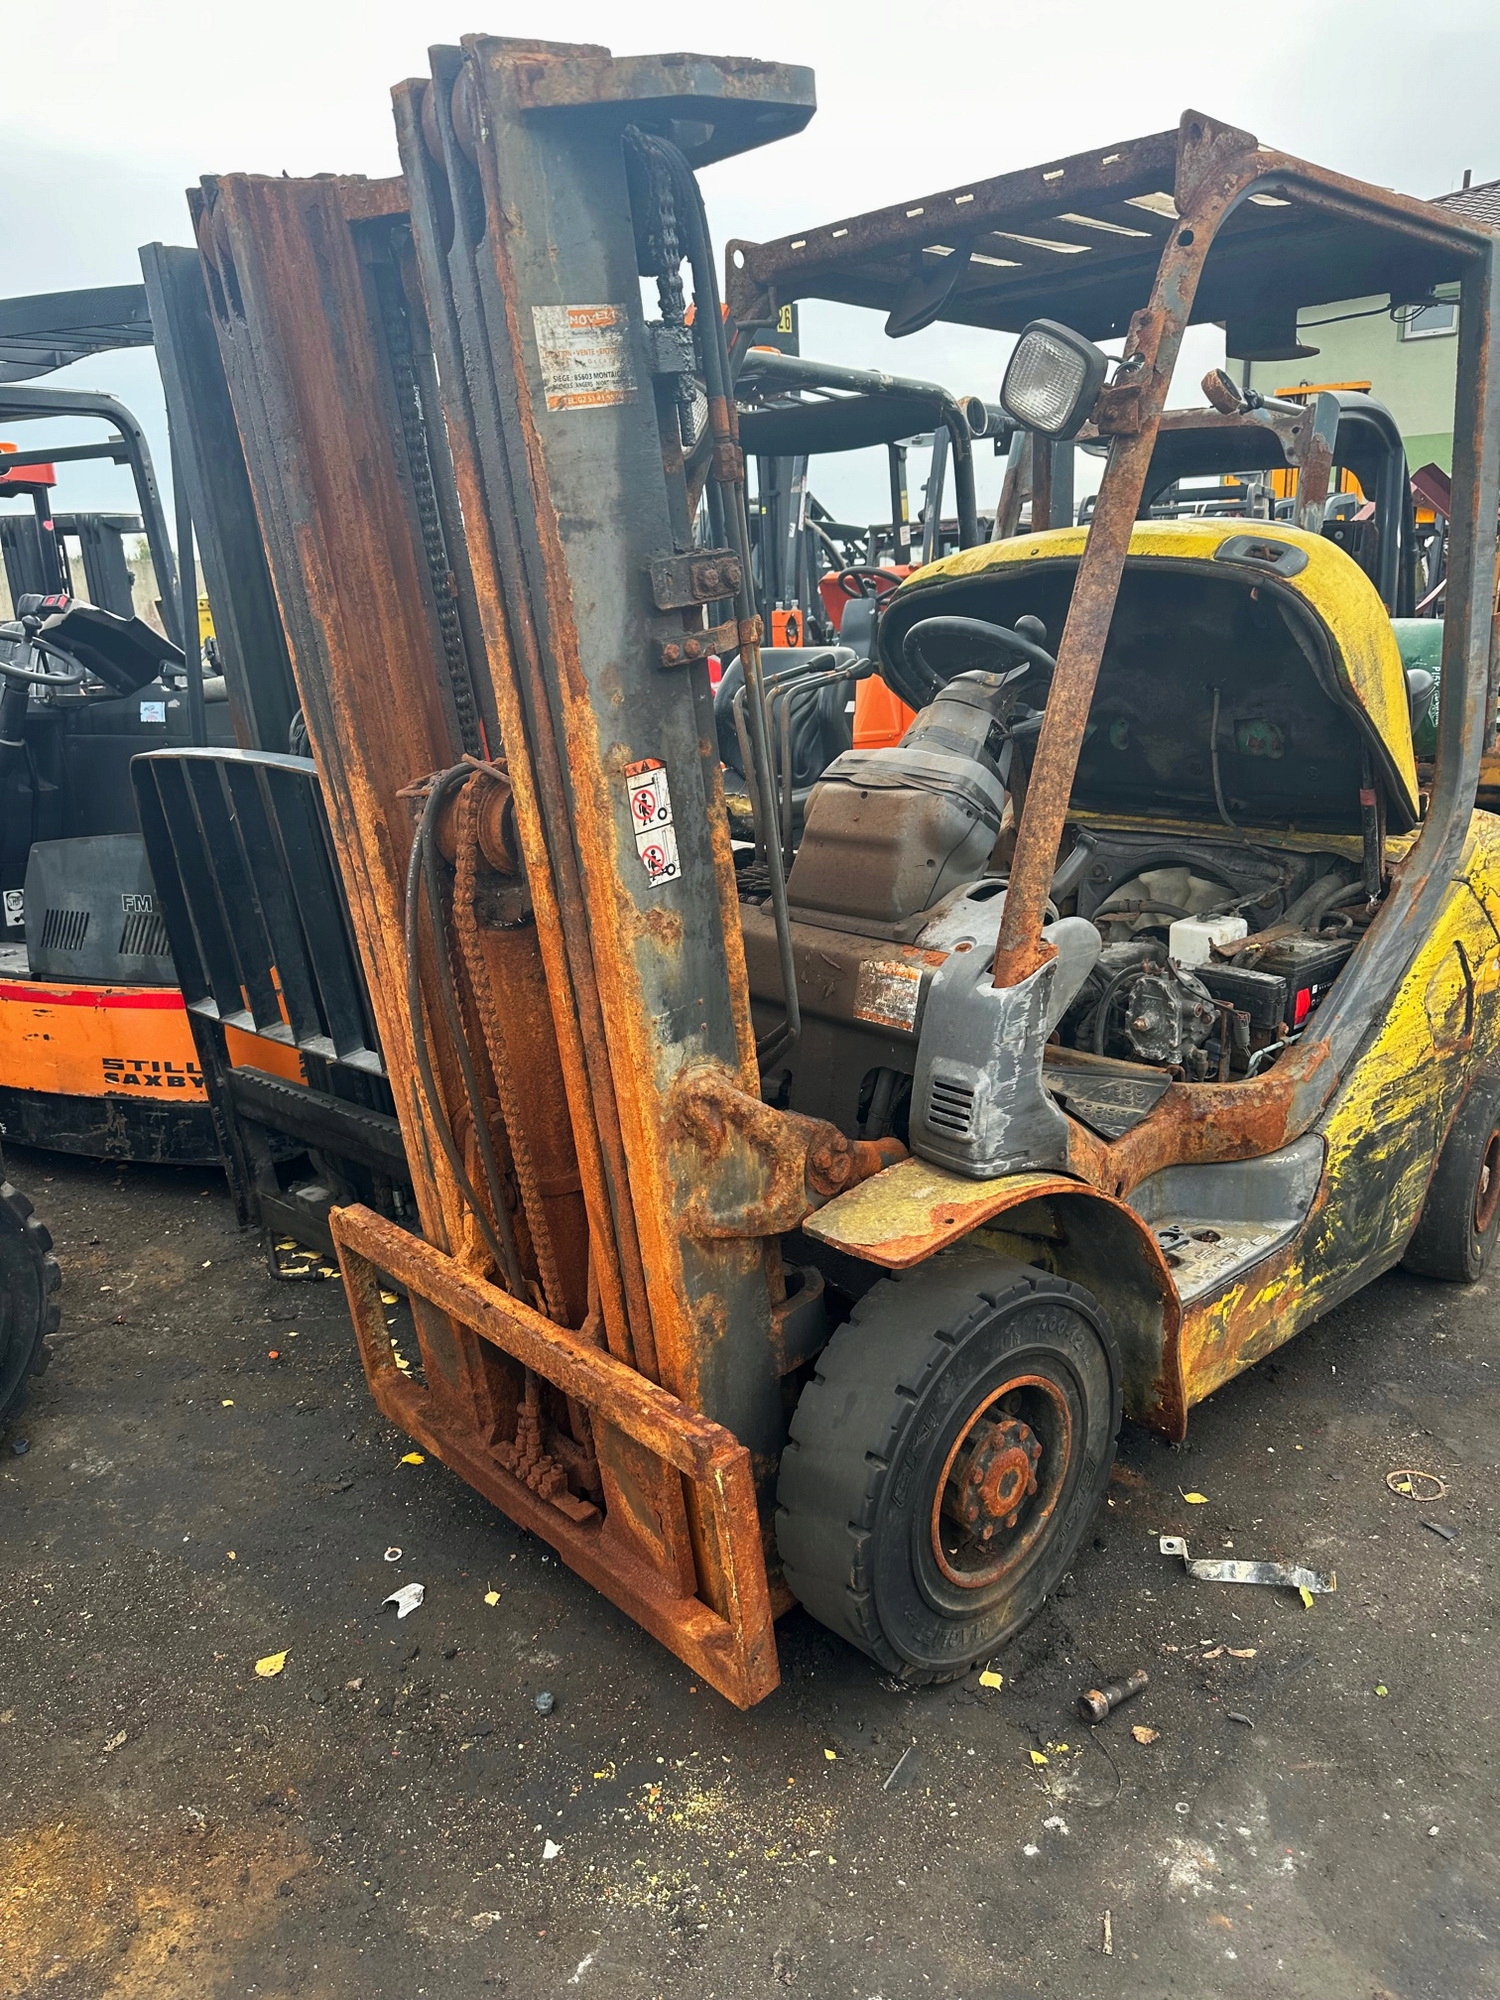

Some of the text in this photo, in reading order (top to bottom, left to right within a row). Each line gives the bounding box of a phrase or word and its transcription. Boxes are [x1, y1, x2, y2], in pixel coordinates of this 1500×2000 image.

[576, 348, 596, 356] VENTE
[122, 894, 152, 912] FM
[102, 1058, 202, 1073] STILL
[104, 1072, 204, 1088] SAXBY
